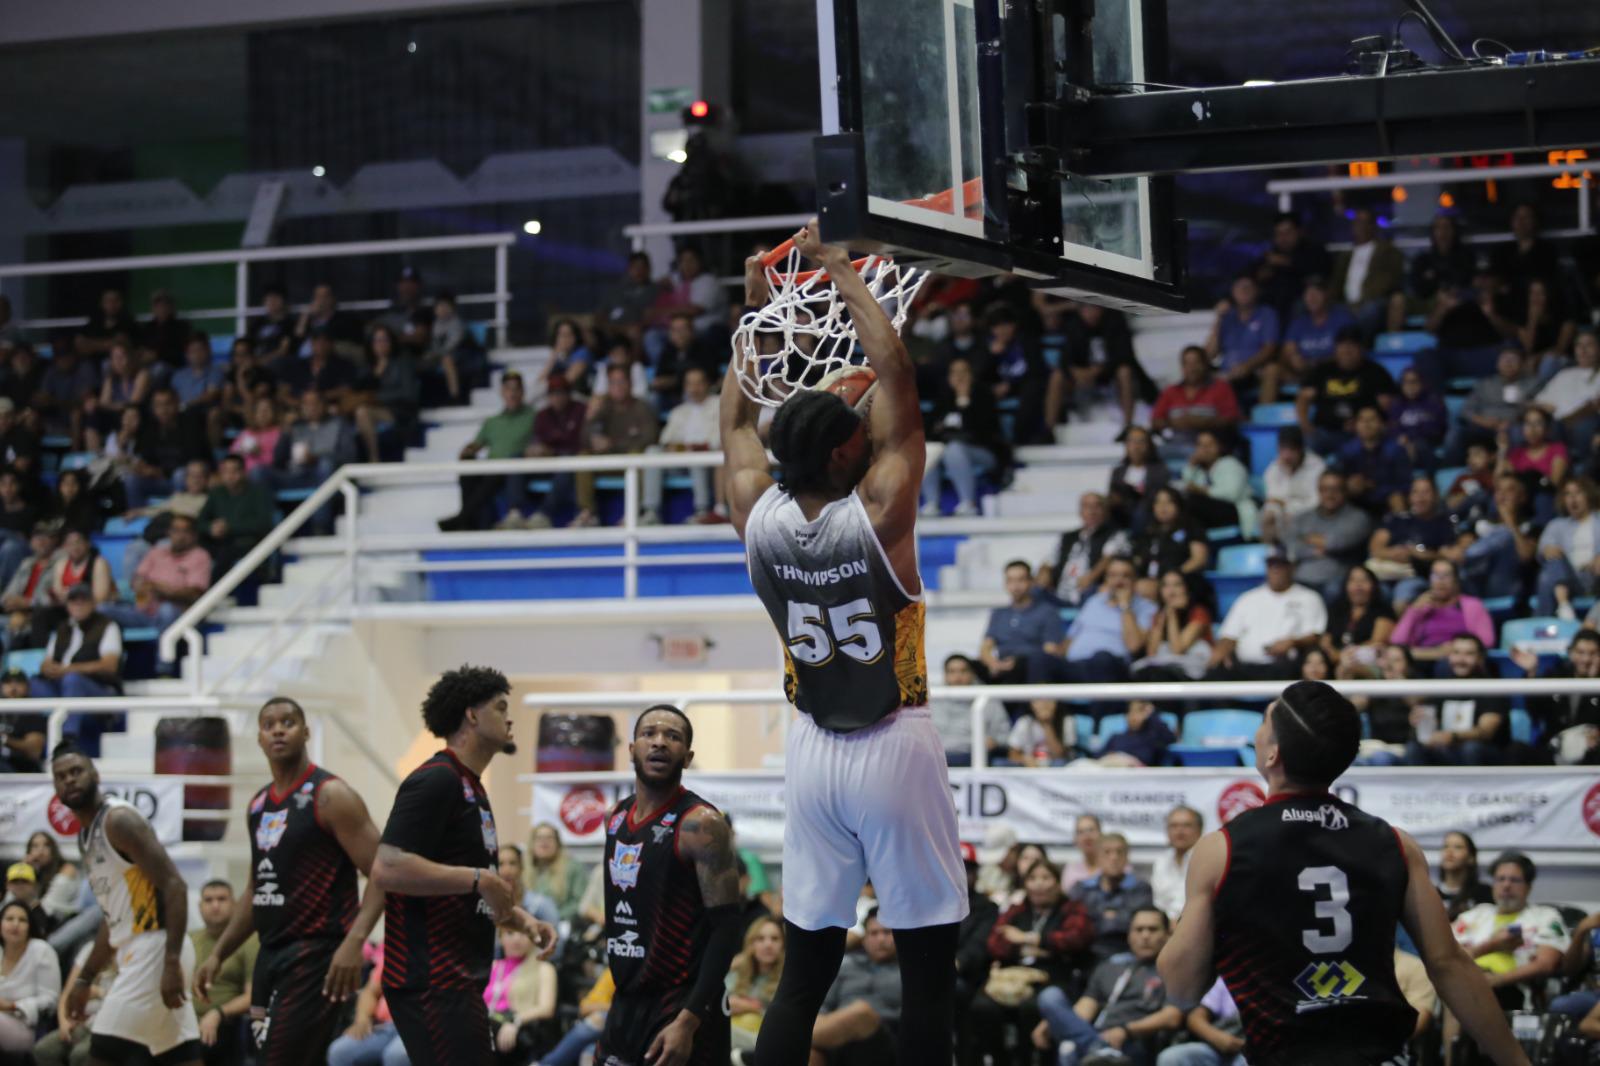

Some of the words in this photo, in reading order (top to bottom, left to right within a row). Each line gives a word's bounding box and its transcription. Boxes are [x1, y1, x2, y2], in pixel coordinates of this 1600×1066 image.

[773, 559, 868, 586] THOMPSON
[786, 598, 885, 667] 55
[1297, 865, 1353, 954] 3
